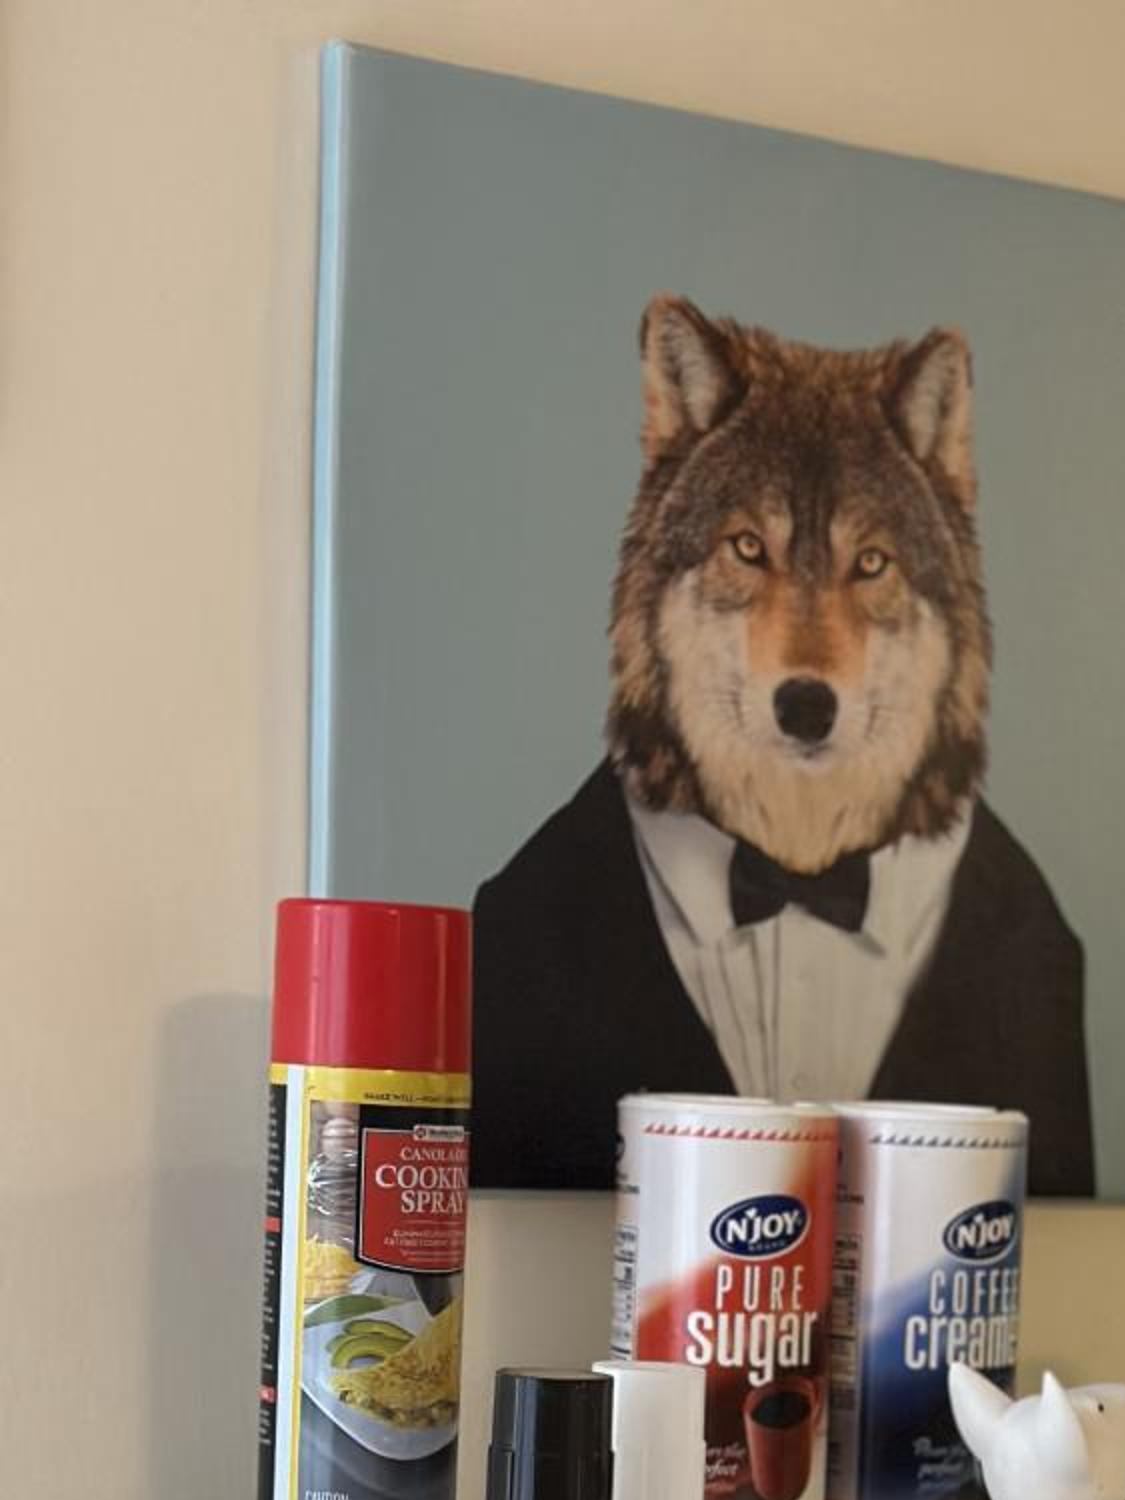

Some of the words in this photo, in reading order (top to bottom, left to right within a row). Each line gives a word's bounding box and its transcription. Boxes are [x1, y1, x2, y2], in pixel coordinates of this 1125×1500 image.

[375, 1164, 468, 1189] COOKIN
[715, 1264, 804, 1311] PURE
[685, 1311, 818, 1388] sugar
[904, 1315, 1015, 1371] cream
